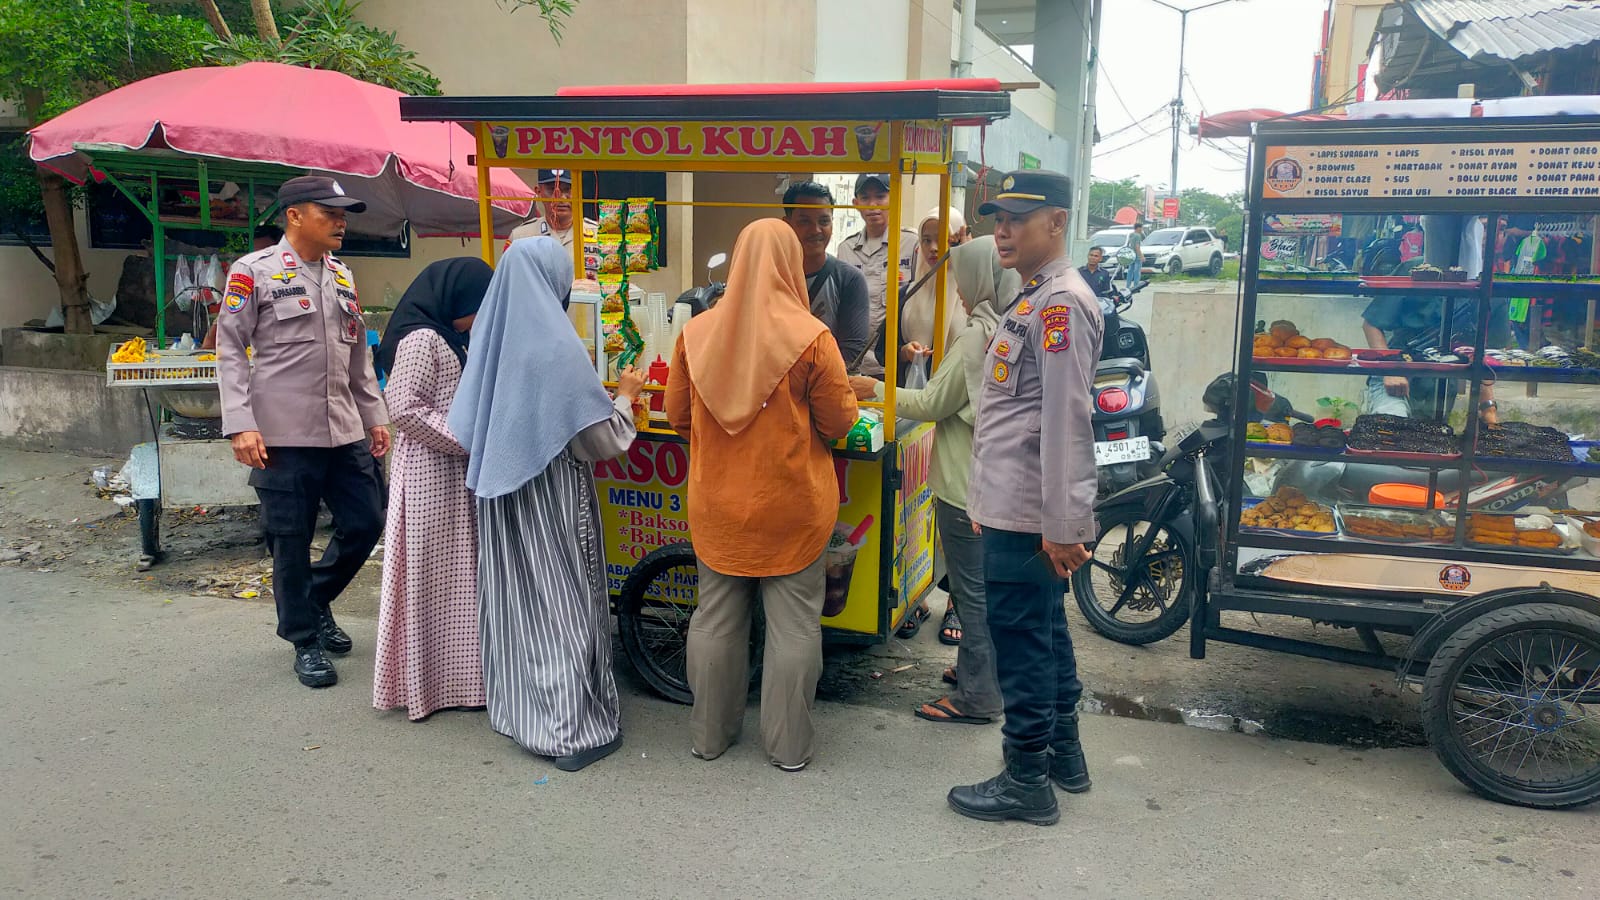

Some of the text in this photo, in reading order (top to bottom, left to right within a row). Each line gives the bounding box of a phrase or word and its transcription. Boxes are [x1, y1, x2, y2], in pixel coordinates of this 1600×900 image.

[515, 125, 847, 158] PENTOL KUAH
[1317, 150, 1379, 158] LAPIS SURABAYA
[1395, 149, 1419, 157] LAPIS
[1459, 148, 1514, 156] RISOL AYAM
[1539, 147, 1597, 155] DONAT OREO
[1393, 163, 1443, 171] MARTABAK
[1458, 162, 1517, 170] DONAT AYAM
[1537, 162, 1568, 170] DONAT
[1571, 161, 1595, 169] KEJU
[1536, 174, 1567, 182] DONAT
[1314, 188, 1369, 196] RISOL SAYUR
[1488, 187, 1517, 195] BLACK
[1534, 187, 1599, 195] LEMPER AYAM
[1042, 306, 1067, 317] POLDA
[609, 488, 681, 512] MENU 3
